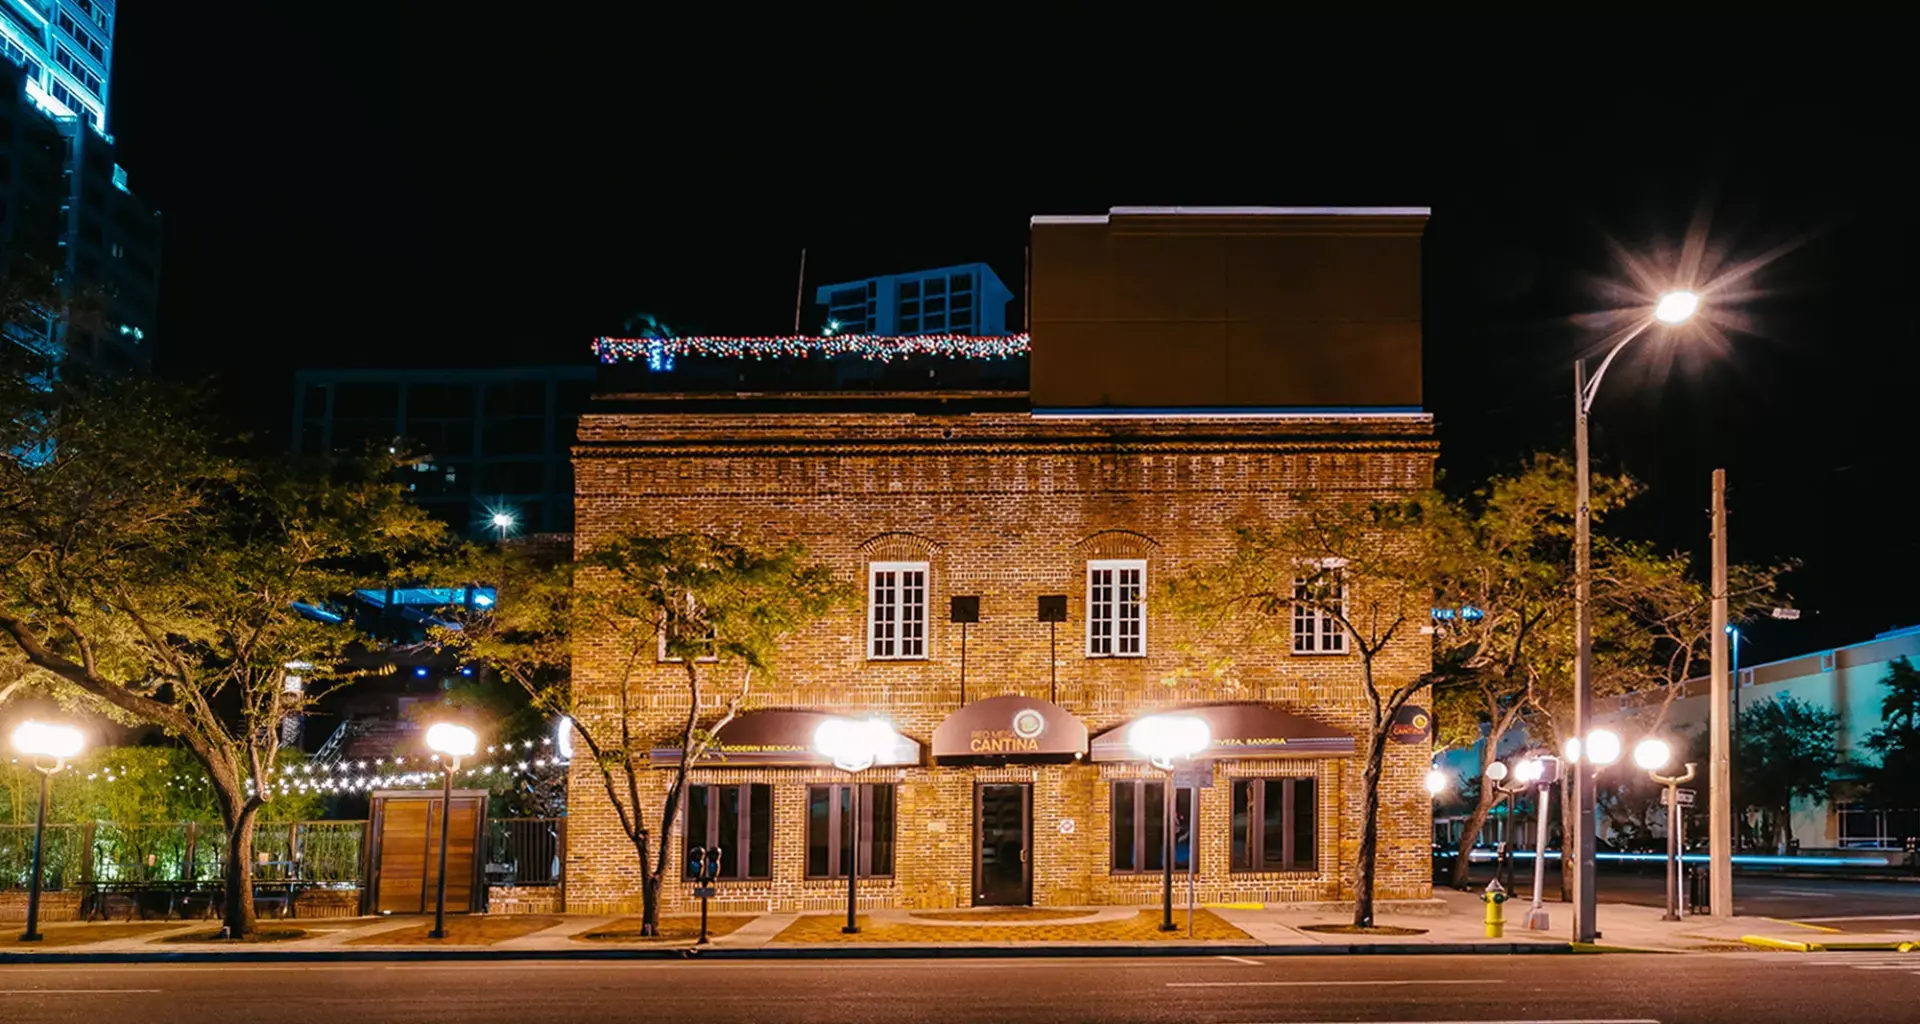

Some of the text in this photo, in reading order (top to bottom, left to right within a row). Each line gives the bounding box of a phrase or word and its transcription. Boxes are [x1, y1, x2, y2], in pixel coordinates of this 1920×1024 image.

[970, 738, 1039, 752] CANTINA
[1246, 737, 1287, 745] SANGRIA
[721, 744, 760, 752] MODERN
[762, 744, 805, 752] MEXICAN
